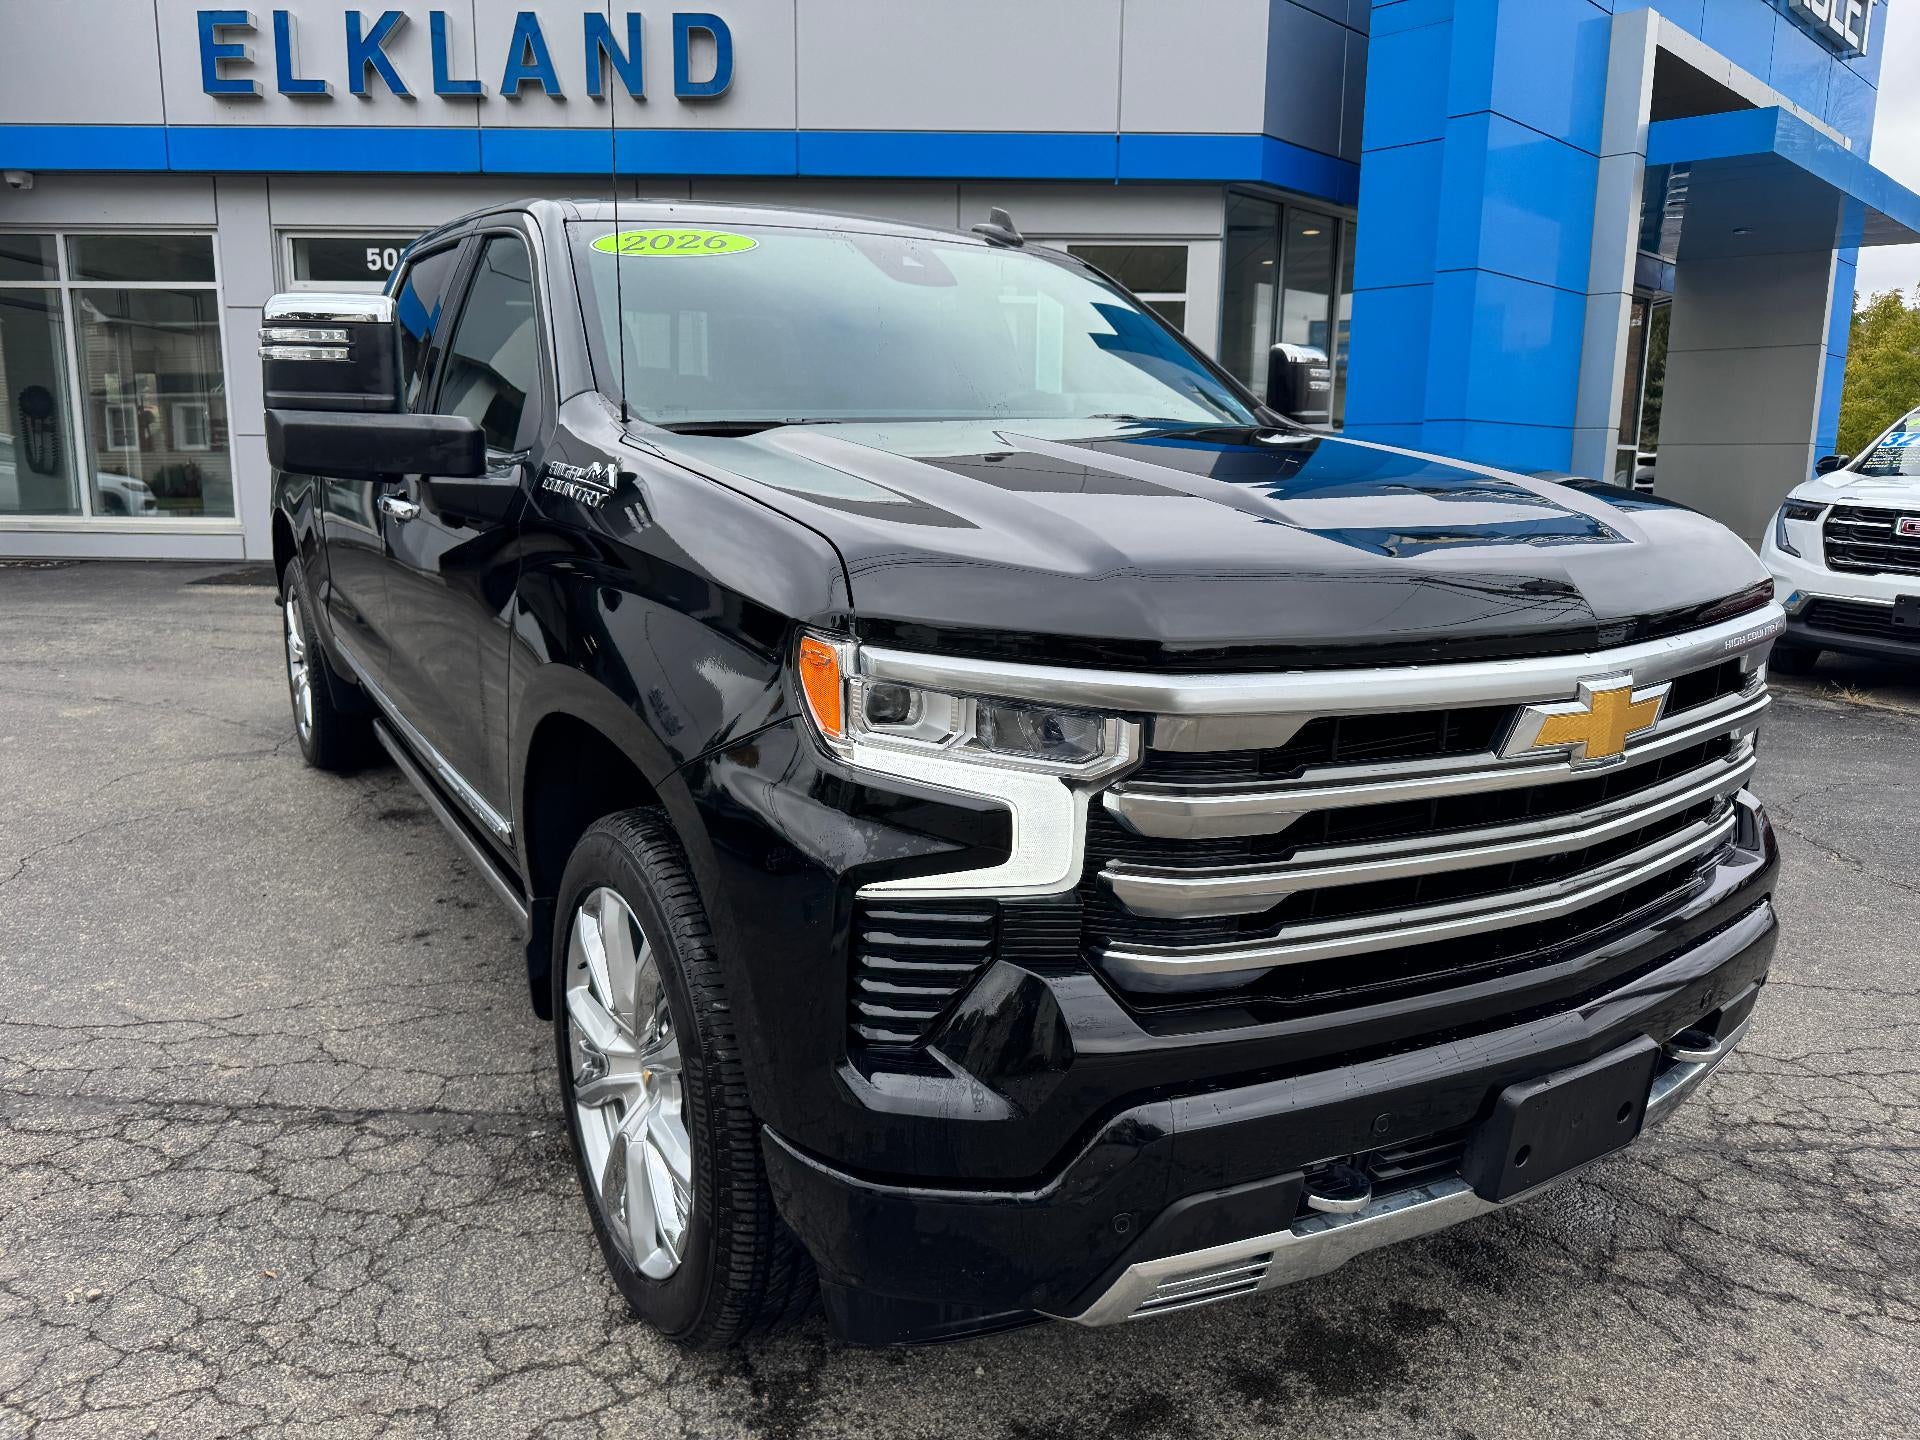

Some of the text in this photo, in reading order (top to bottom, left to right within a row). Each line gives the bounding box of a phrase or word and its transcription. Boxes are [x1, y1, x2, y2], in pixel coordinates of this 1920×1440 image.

[197, 10, 735, 99] ELKLAND
[621, 234, 728, 251] 2026
[366, 247, 406, 271] 50
[542, 477, 600, 508] COUNTRY
[1725, 622, 1779, 650] HIGH COUNTRY
[688, 1057, 713, 1227] BRIDGESTONE
